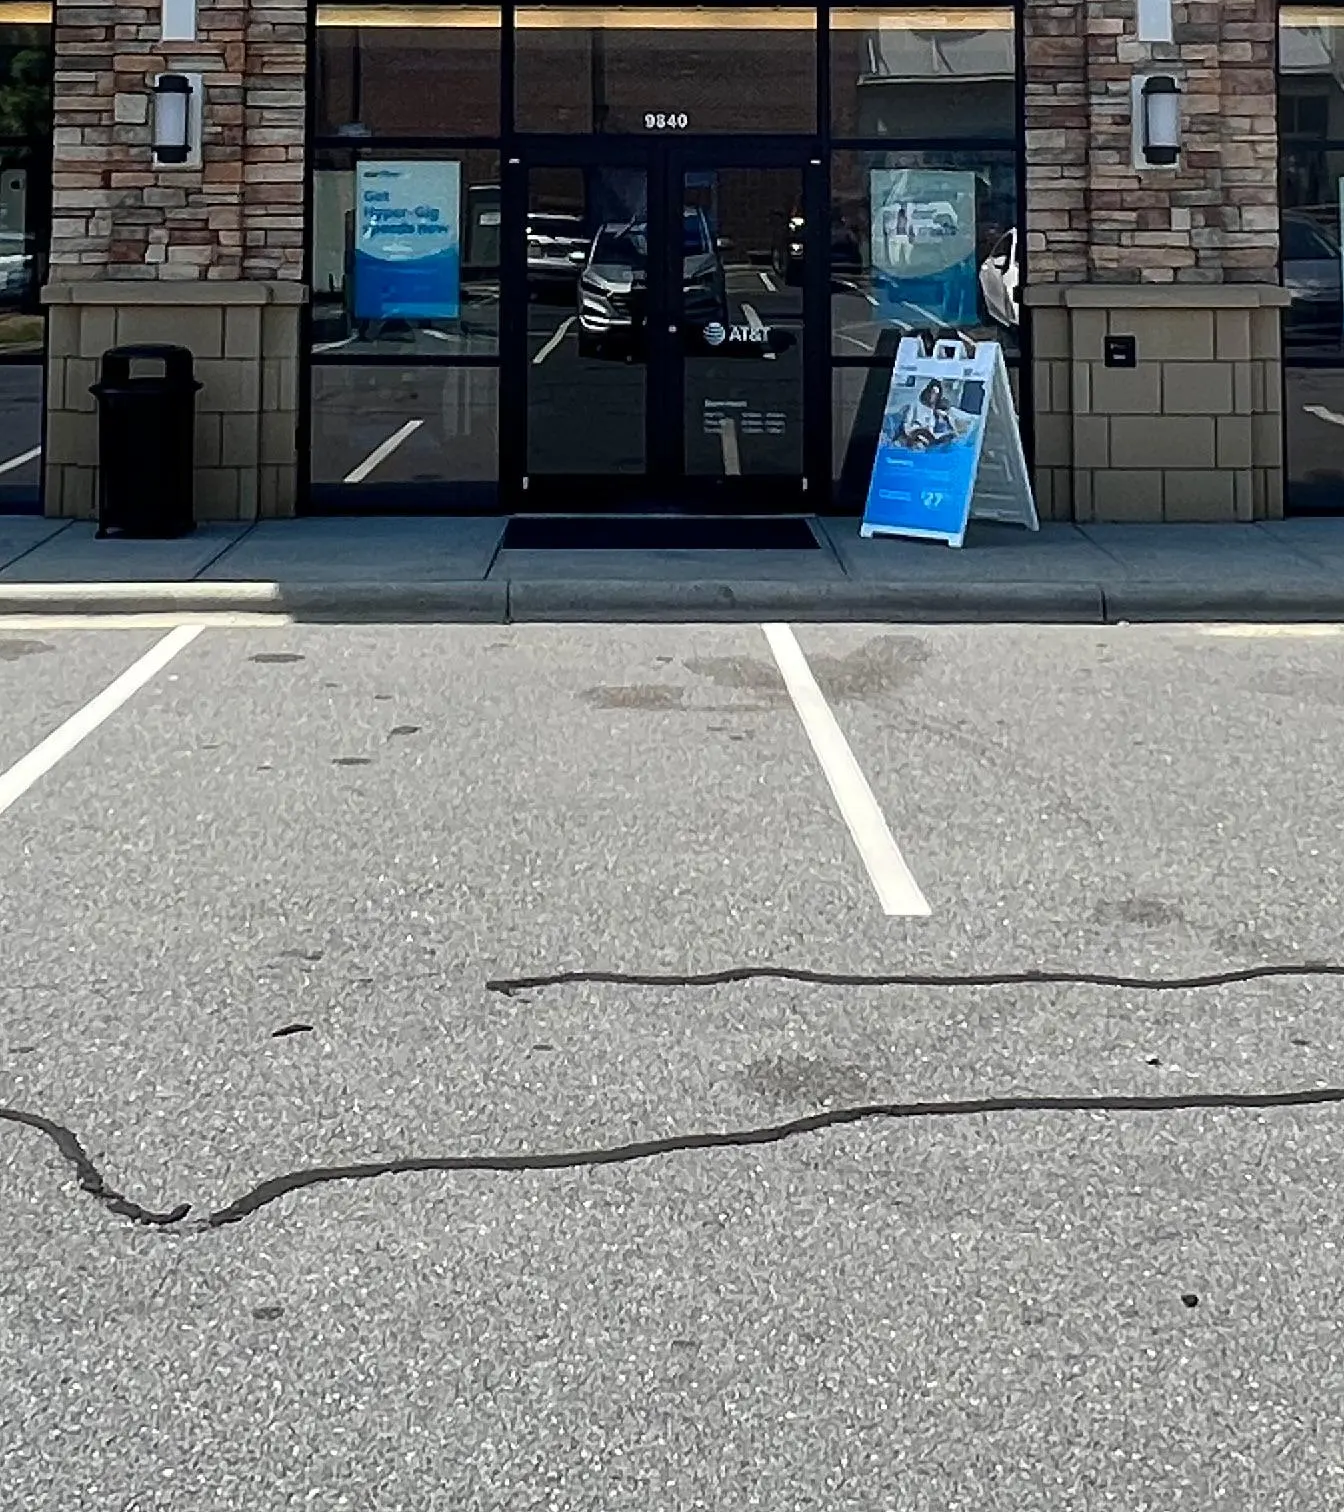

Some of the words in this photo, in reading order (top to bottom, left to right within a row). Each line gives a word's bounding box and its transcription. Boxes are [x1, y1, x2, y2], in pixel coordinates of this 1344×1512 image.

[644, 113, 688, 128] 9840
[364, 190, 390, 202] Get
[728, 326, 772, 342] AT&T
